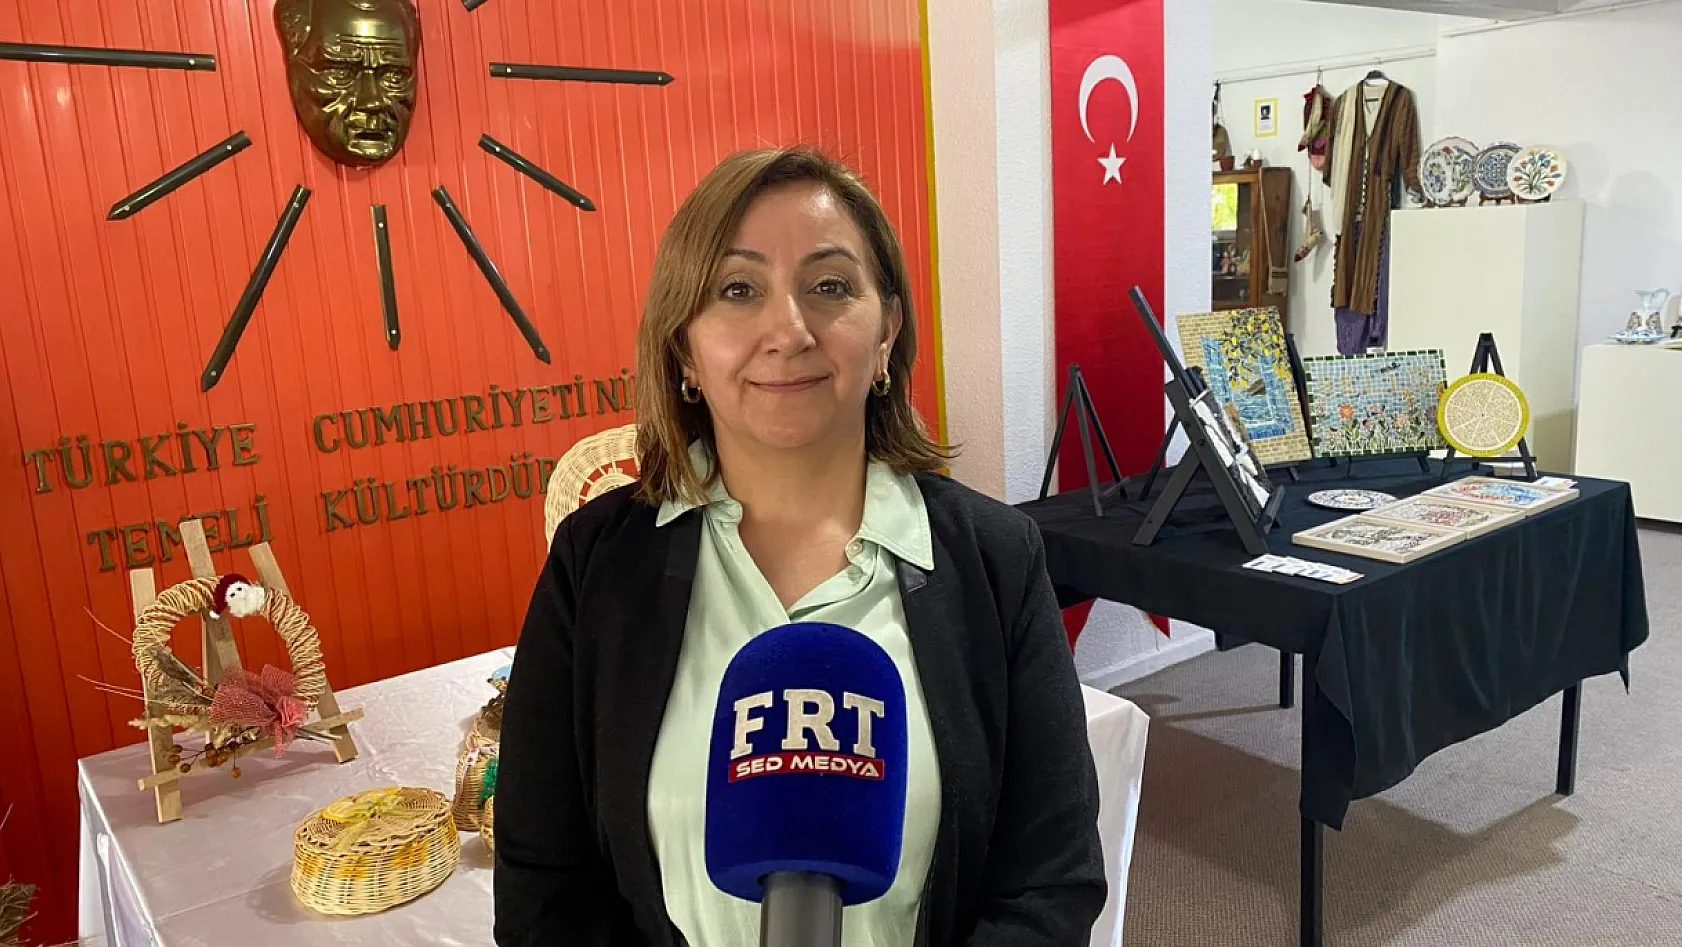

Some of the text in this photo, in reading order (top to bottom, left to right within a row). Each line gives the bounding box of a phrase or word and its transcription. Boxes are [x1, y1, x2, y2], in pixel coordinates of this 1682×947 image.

[25, 422, 259, 494] TÜRKİYE
[730, 689, 885, 760] FRT
[735, 755, 880, 778] SED MEDYA
